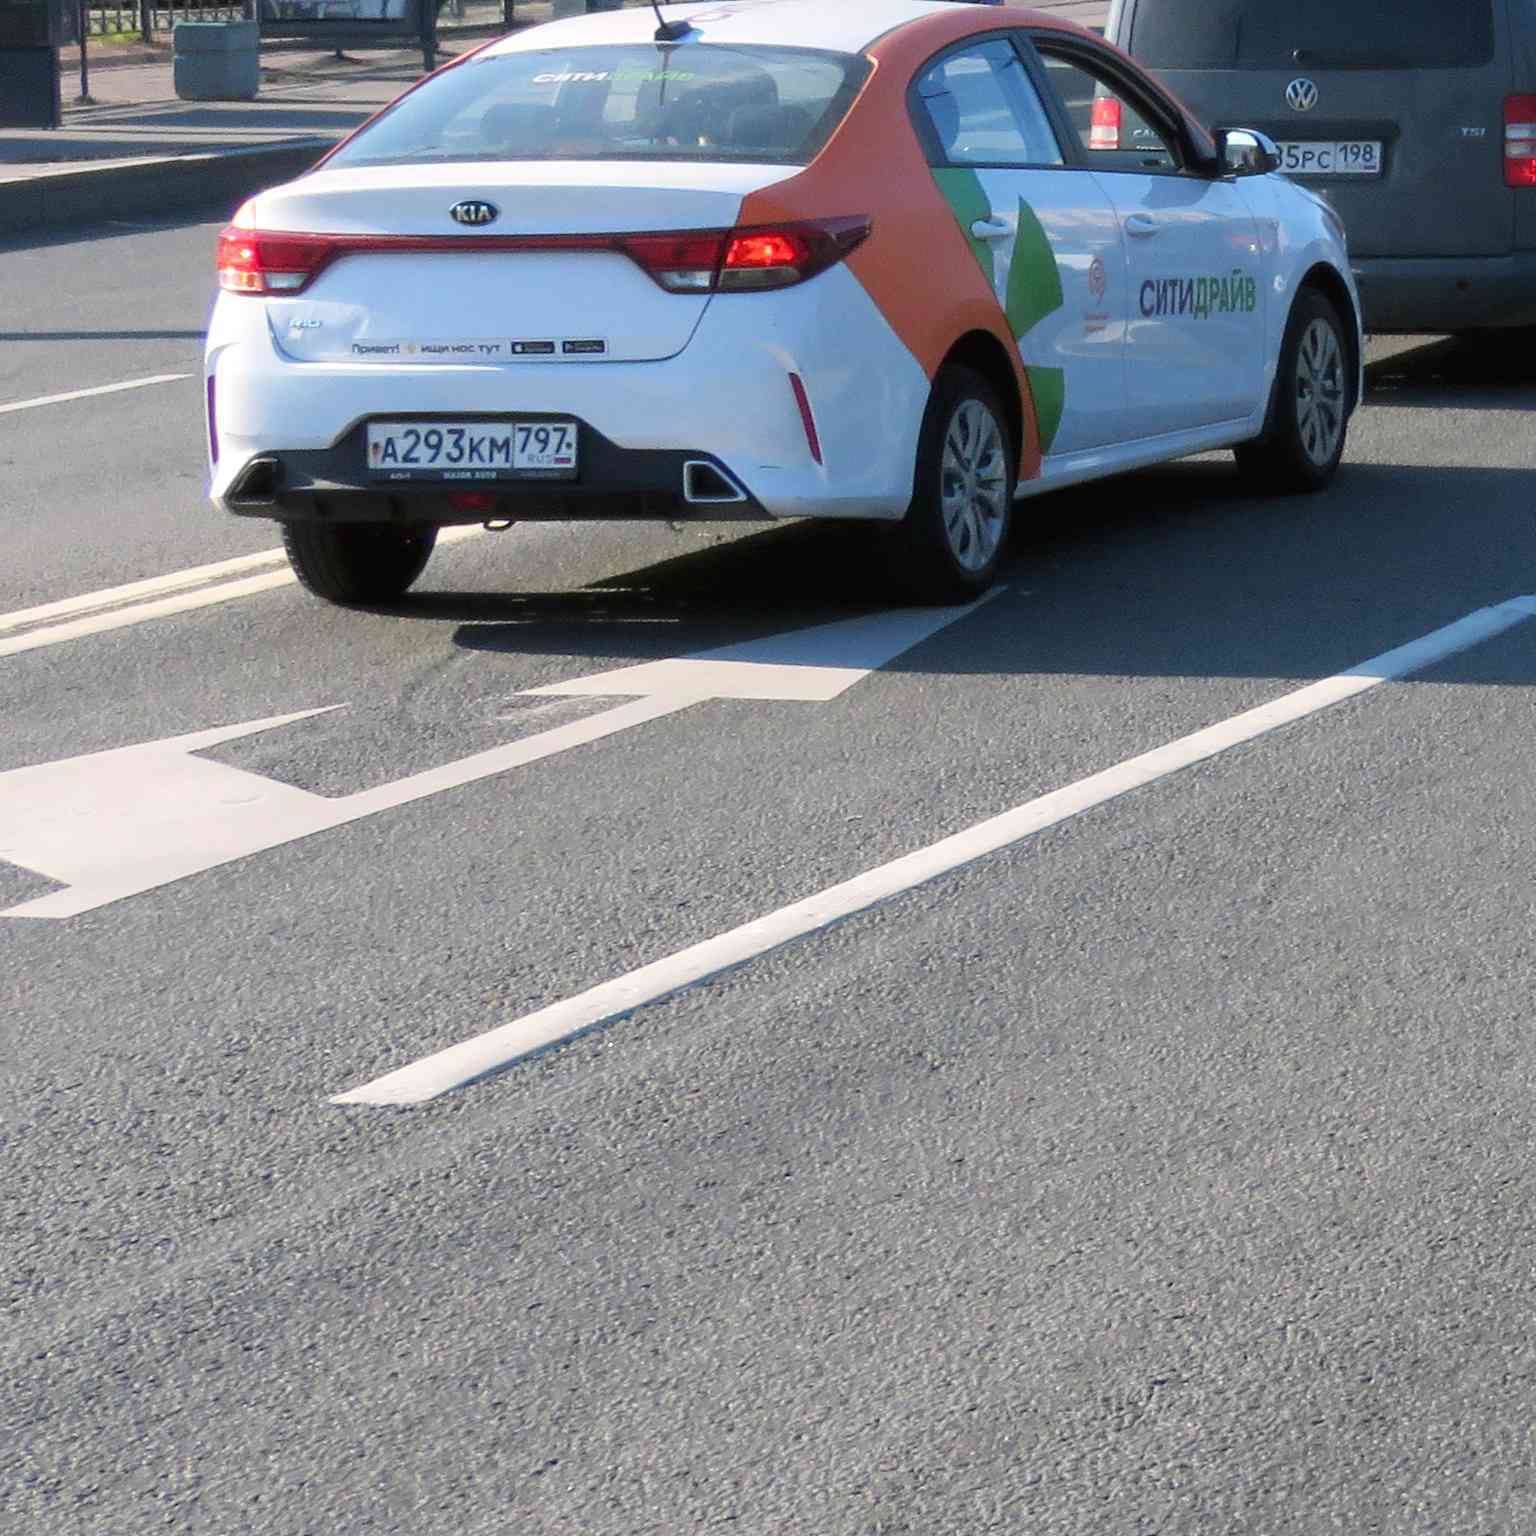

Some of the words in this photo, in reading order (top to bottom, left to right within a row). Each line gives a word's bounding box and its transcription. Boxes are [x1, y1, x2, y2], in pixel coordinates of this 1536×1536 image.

[1338, 143, 1374, 163] 198
[455, 204, 492, 221] KIA
[1139, 269, 1256, 320] СИТИДРАЙВ
[478, 344, 501, 354] тут
[381, 428, 511, 464] А293КМ
[517, 426, 568, 455] 797
